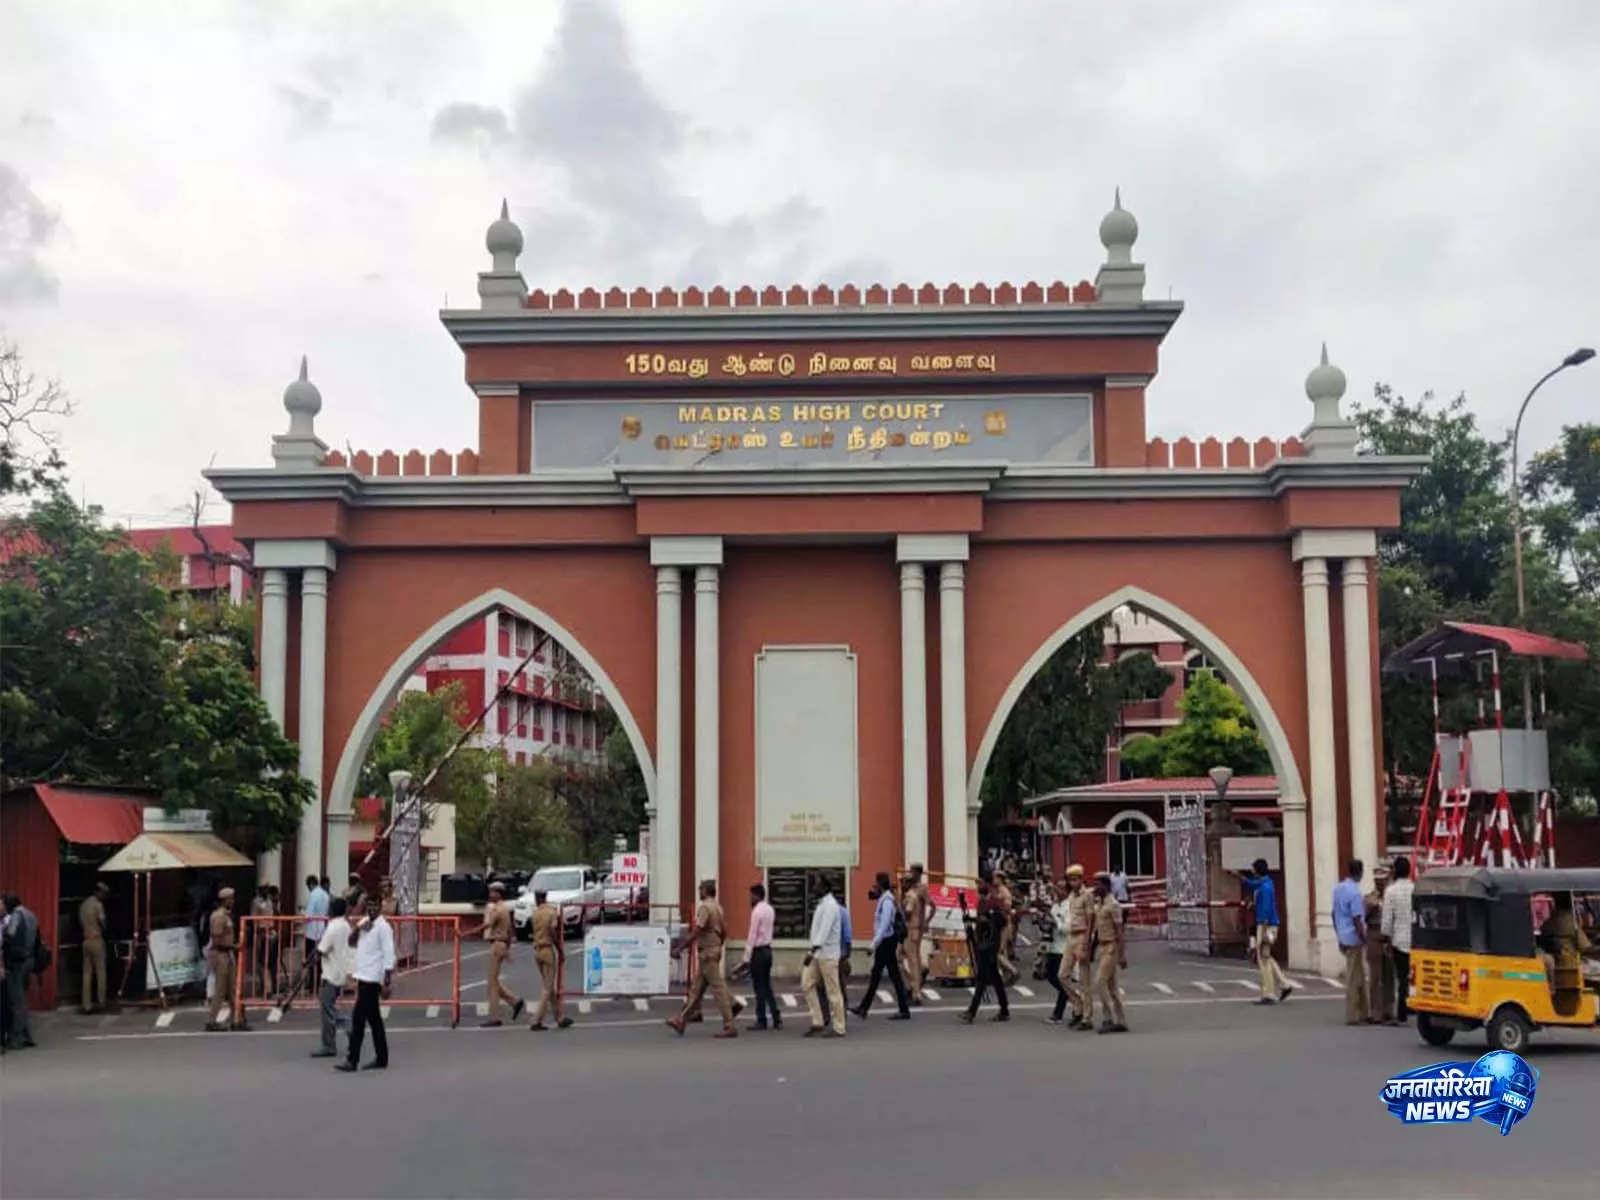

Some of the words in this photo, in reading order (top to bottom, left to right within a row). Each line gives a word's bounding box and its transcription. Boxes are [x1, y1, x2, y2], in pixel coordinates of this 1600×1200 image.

[624, 354, 708, 378] 150வது
[722, 352, 795, 376] ஆண்டு
[808, 352, 897, 374] நினைவு
[911, 354, 996, 372] வளைவு
[678, 406, 782, 422] MADRAS
[793, 404, 851, 421] HIGH
[862, 402, 944, 419] COURT
[623, 856, 637, 868] NO
[614, 872, 645, 884] ENTRY
